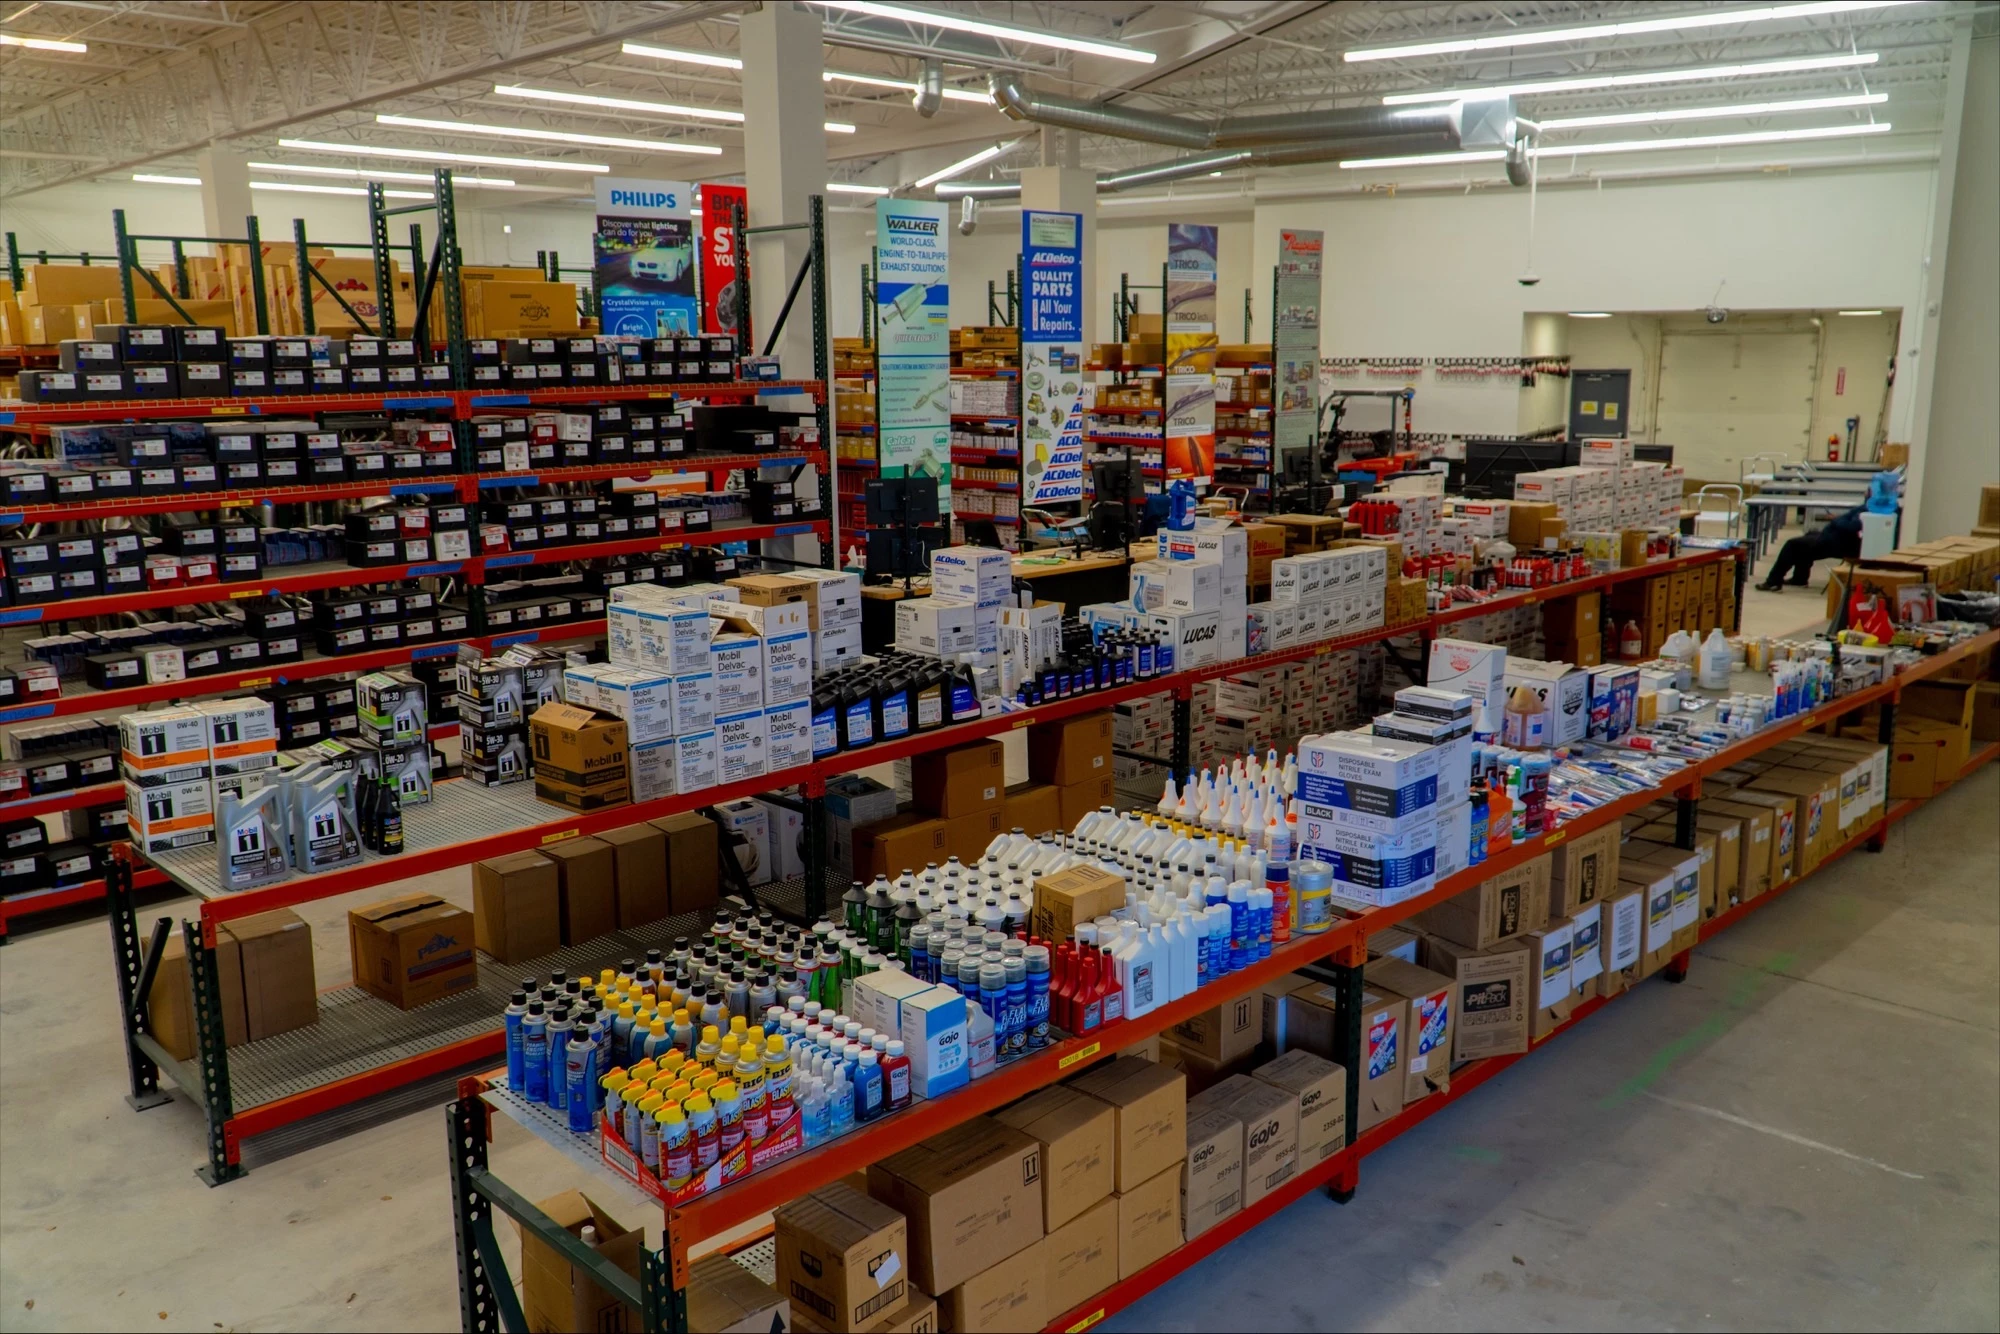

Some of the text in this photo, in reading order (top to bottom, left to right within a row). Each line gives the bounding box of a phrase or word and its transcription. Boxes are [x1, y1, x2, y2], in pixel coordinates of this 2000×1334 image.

[611, 190, 677, 209] PHILIPS
[602, 219, 678, 232] Discover what lighting
[886, 215, 939, 236] WALKER
[617, 228, 627, 236] do
[628, 228, 638, 236] for
[1032, 252, 1075, 264] ACDelco
[880, 262, 946, 273] EXHAUST SOLUTIONS
[1174, 259, 1199, 270] TRICO
[1032, 271, 1073, 282] QUALITY
[1032, 282, 1073, 297] PARTS
[607, 299, 649, 307] CrystalVision
[1040, 299, 1072, 314] All Your
[1174, 312, 1197, 321] TRICO
[622, 323, 643, 332] Bright
[1040, 317, 1076, 334] Repairs.
[1173, 417, 1195, 426] TRICO
[1167, 467, 1182, 475] TRICO
[1035, 485, 1081, 499] ACDelco
[1198, 541, 1218, 550] LUCAS
[935, 555, 966, 566] ACDelco
[981, 556, 1004, 564] ACDelco
[1345, 571, 1361, 583] LUCAS
[1369, 568, 1384, 580] LUCAS
[822, 578, 846, 587] ACDelco
[1275, 579, 1295, 587] LUCAS
[1302, 580, 1320, 593] LUCAS
[1324, 575, 1340, 588] LUCAS
[779, 585, 812, 595] ACDelco
[977, 600, 1002, 608] ACDelco
[1173, 598, 1188, 606] LUCAS
[1098, 615, 1120, 624] Supreme
[1346, 612, 1361, 624] LUCAS
[1366, 608, 1382, 620] LUCAS
[675, 620, 693, 629] Mobil
[1300, 621, 1316, 634] LUCAS
[1324, 618, 1340, 629] LUCAS
[674, 628, 696, 637] Delvac
[822, 628, 846, 636] ACDelco
[1183, 624, 1217, 645] LUCAS
[1276, 625, 1294, 639] LUCAS
[770, 643, 792, 654] Mobil
[718, 650, 741, 661] Mobil
[770, 653, 796, 664] Delvac
[718, 661, 746, 672] Delvac
[678, 681, 697, 690] Mobil
[380, 691, 399, 702] 0W-30
[632, 688, 652, 698] Mobil
[678, 689, 700, 698] Delvac
[633, 696, 655, 706] Delvac
[213, 714, 237, 724] Mobil
[770, 712, 792, 724] Mobil
[140, 725, 165, 735] Mobil
[533, 723, 549, 734] Mobil
[722, 721, 745, 733] Mobil
[770, 722, 797, 733] Delvac
[486, 735, 504, 745] 5W-30
[722, 732, 750, 744] Delvac
[681, 740, 699, 750] Mobil
[637, 748, 656, 758] Mobil
[681, 748, 703, 758] Delvac
[385, 753, 405, 765] 0W-20
[584, 755, 612, 769] Mobil
[638, 756, 660, 766] Delvac
[1338, 756, 1376, 768] DISPOSABLE
[1338, 764, 1382, 777] NITRILE EXAM
[1338, 772, 1363, 781] GLOVES
[218, 778, 242, 789] Mobil
[146, 790, 172, 801] Mobil
[314, 812, 334, 821] Mobil
[1306, 806, 1332, 818] BLACK
[237, 826, 257, 836] Mobil
[1335, 829, 1372, 842] DISPOSABLE
[1335, 837, 1357, 846] NITRILE
[1335, 844, 1359, 854] GLOVES
[939, 1031, 959, 1046] GOJO
[978, 1040, 991, 1049] GOJO
[772, 1064, 791, 1079] BIG
[892, 1068, 908, 1079] GOJO
[742, 1075, 763, 1089] BIG
[868, 1078, 881, 1089] GOJO
[1301, 1090, 1322, 1107] GOJO
[1323, 1114, 1344, 1132] 2358-02
[1249, 1120, 1280, 1148] GOJO
[1193, 1144, 1215, 1163] GOJO
[1216, 1160, 1241, 1180] 0979-02
